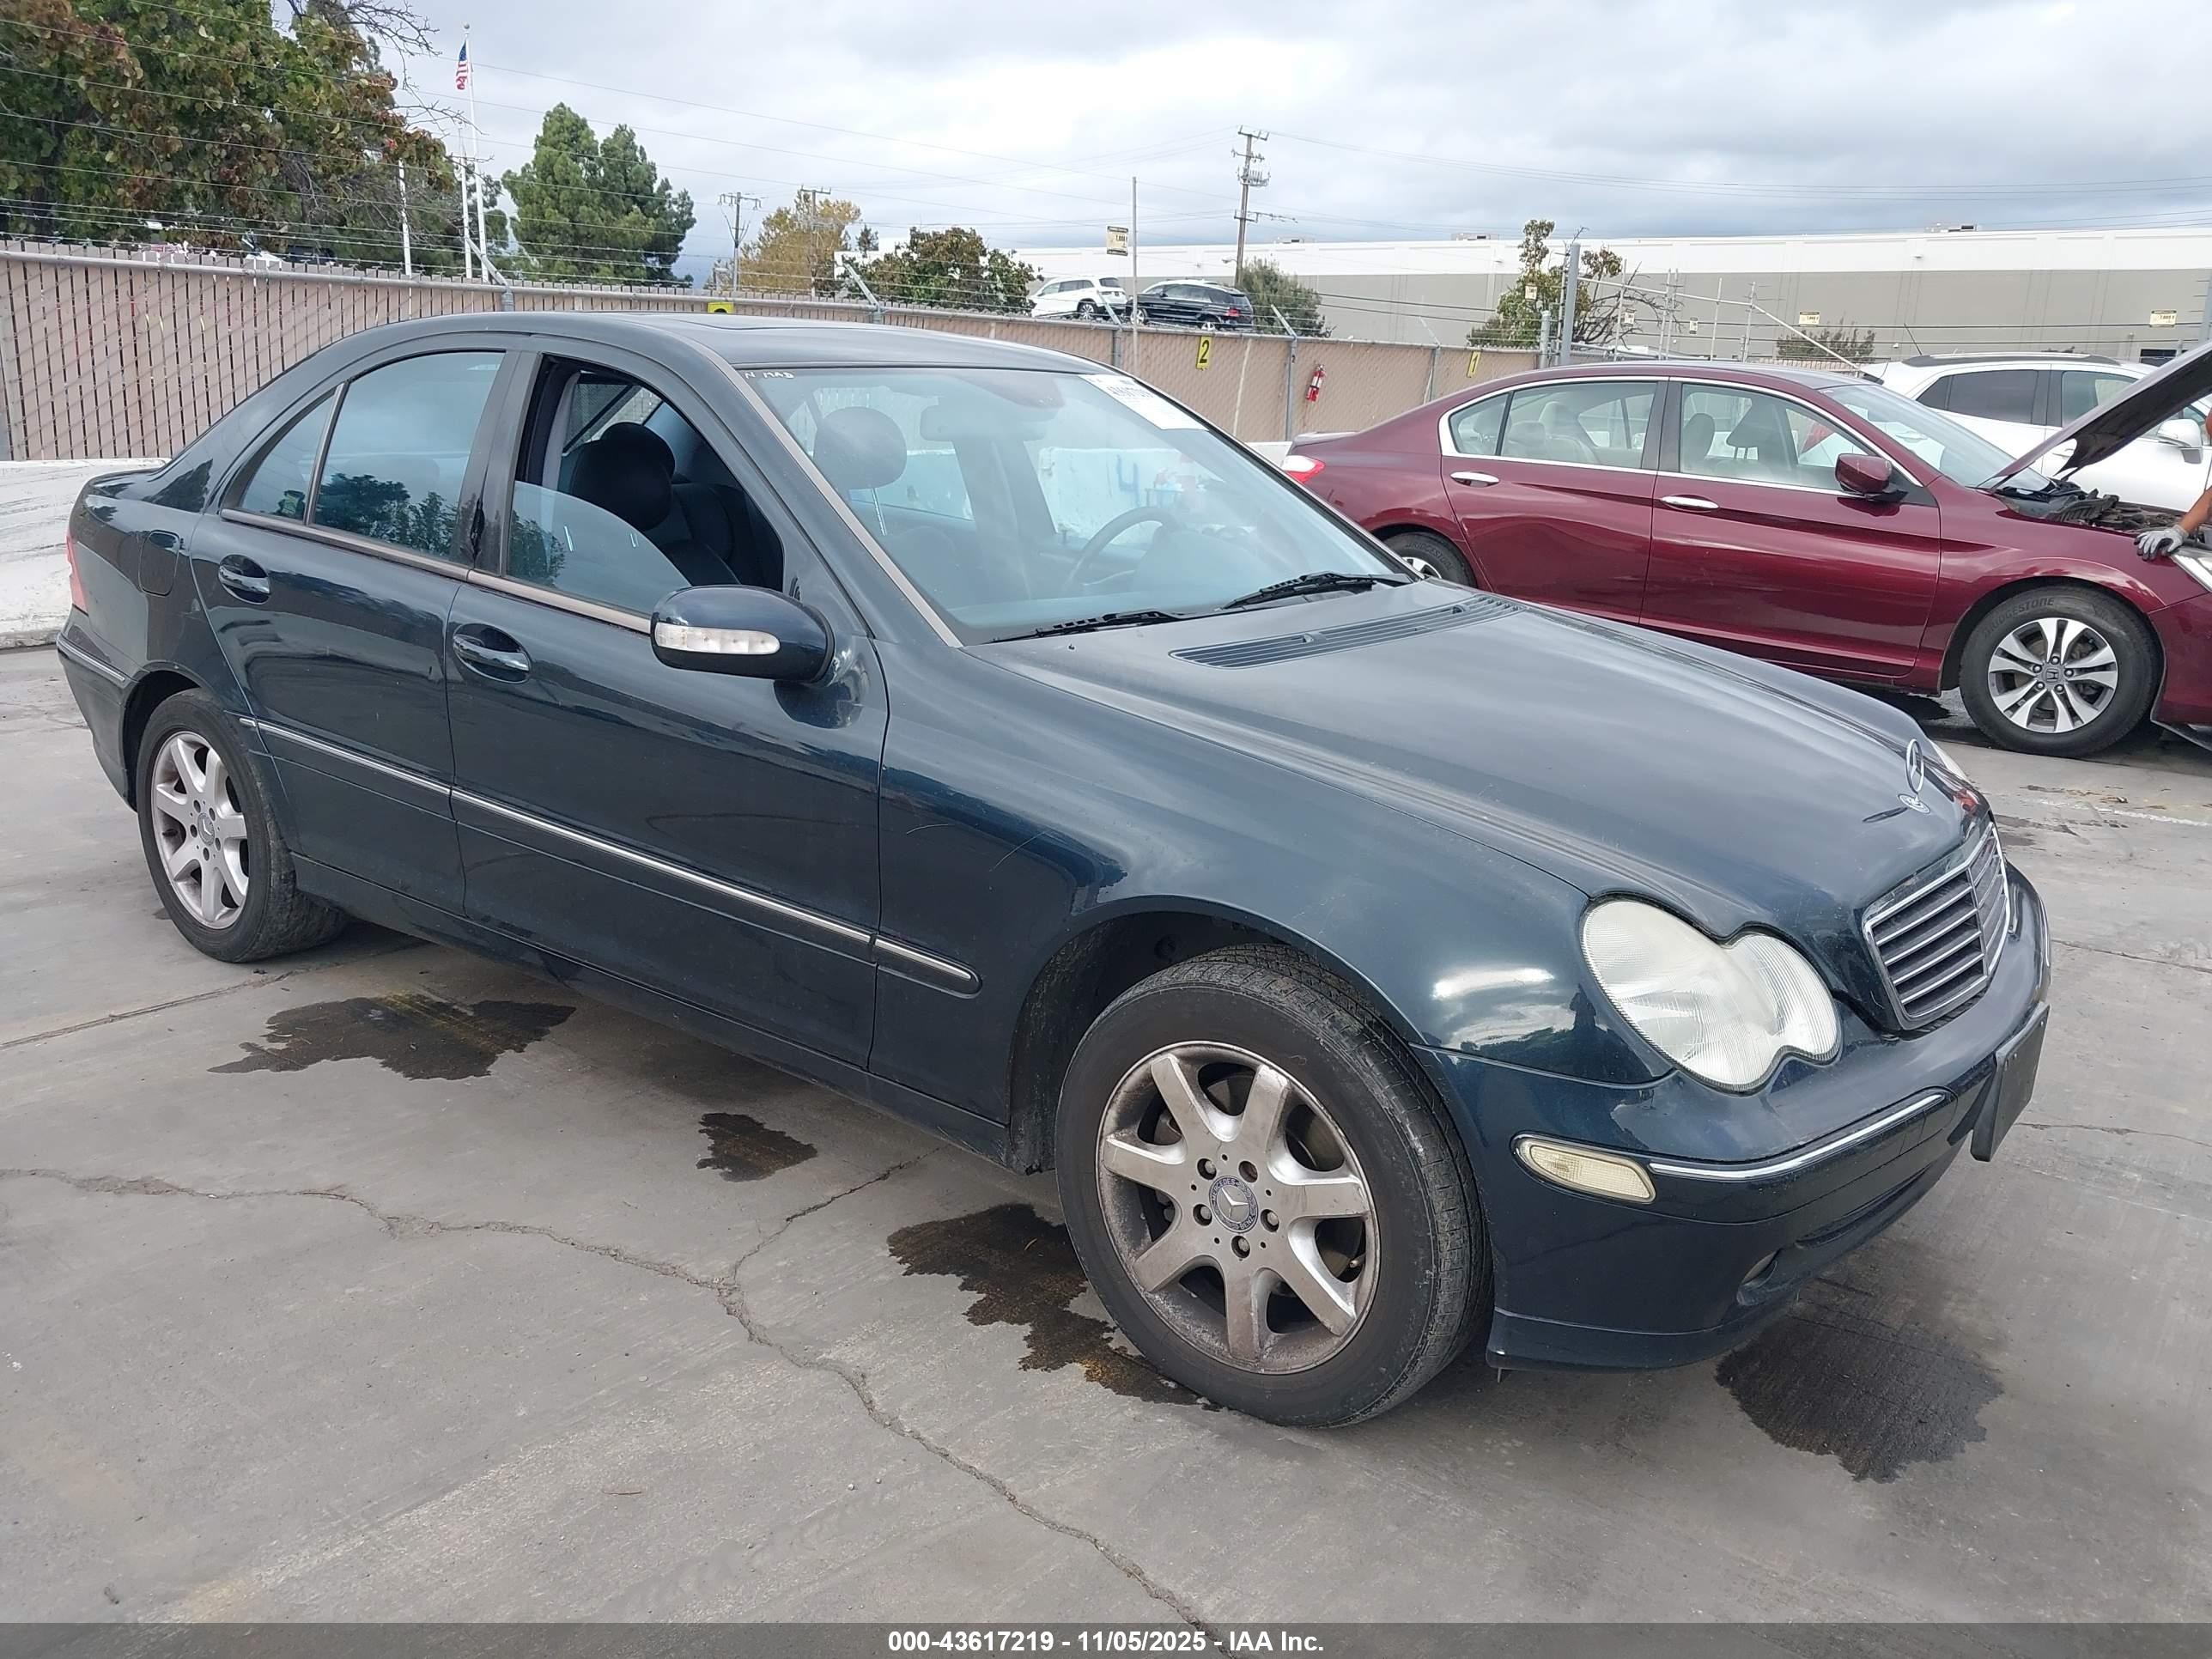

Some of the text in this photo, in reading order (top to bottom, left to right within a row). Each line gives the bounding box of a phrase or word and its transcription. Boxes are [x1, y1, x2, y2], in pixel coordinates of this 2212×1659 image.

[1199, 339, 1210, 364] 2
[1472, 354, 1479, 373] 1
[1211, 1178, 1237, 1201] MERCEDES
[1240, 1215, 1255, 1230] BENZ
